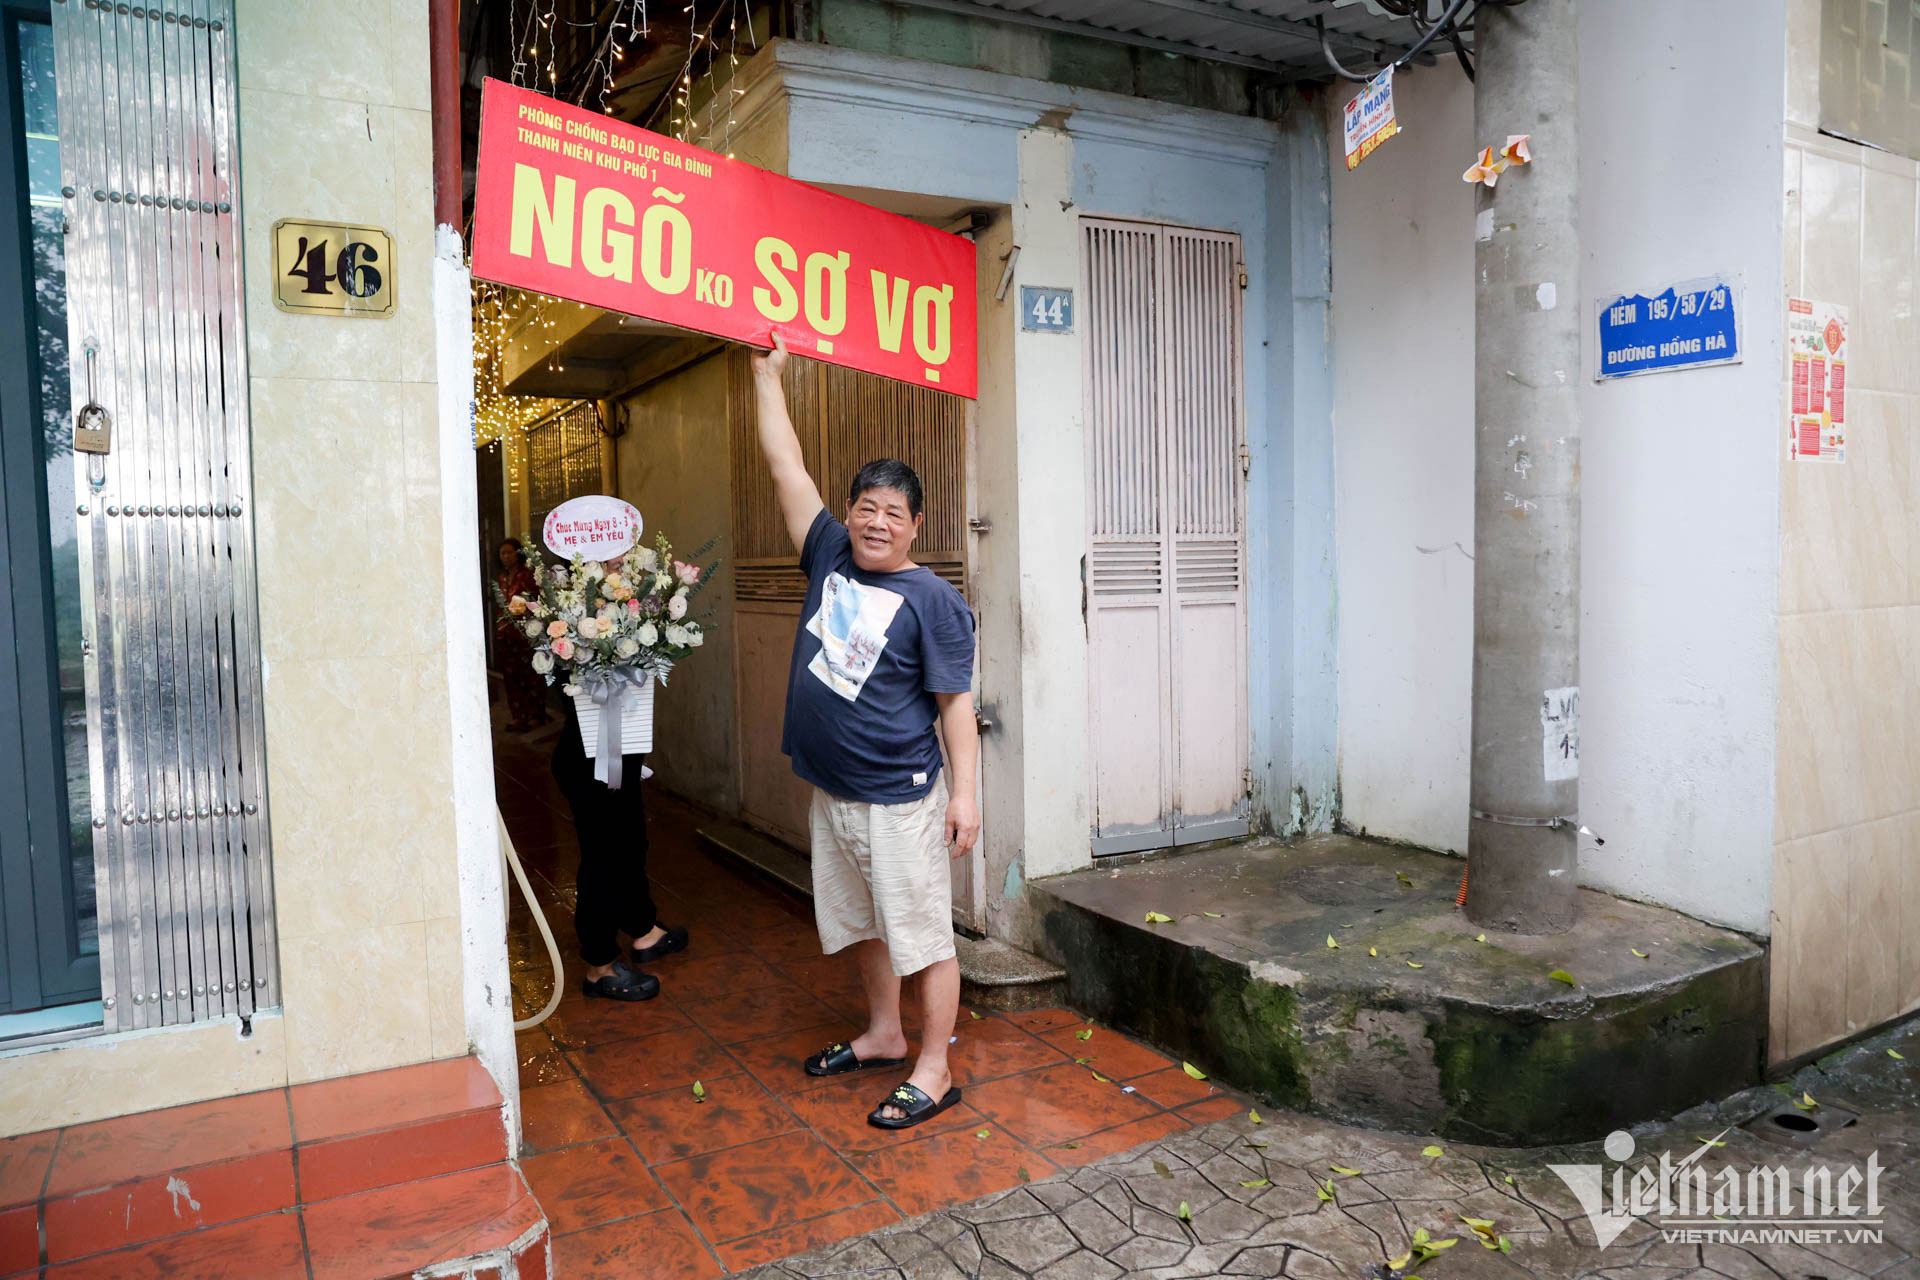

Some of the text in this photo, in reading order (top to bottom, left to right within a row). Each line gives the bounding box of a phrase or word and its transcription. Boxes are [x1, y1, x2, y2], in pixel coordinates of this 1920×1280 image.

[1364, 84, 1390, 116] MẠNG
[518, 104, 712, 178] PHÒNG CHỐNG BẠO LỰC GIA ĐÌNH
[518, 127, 657, 183] THANH NIÊN KHU PHỐ 1
[288, 237, 382, 298] 46
[510, 162, 692, 295] NGÕ
[753, 236, 850, 355] SỢ
[870, 268, 954, 383] VỢ
[1610, 298, 1637, 327] HẺM
[1608, 330, 1727, 365] ĐƯỜNG HỒNG HÀ
[564, 535, 577, 547] MẸ
[591, 532, 603, 543] EM
